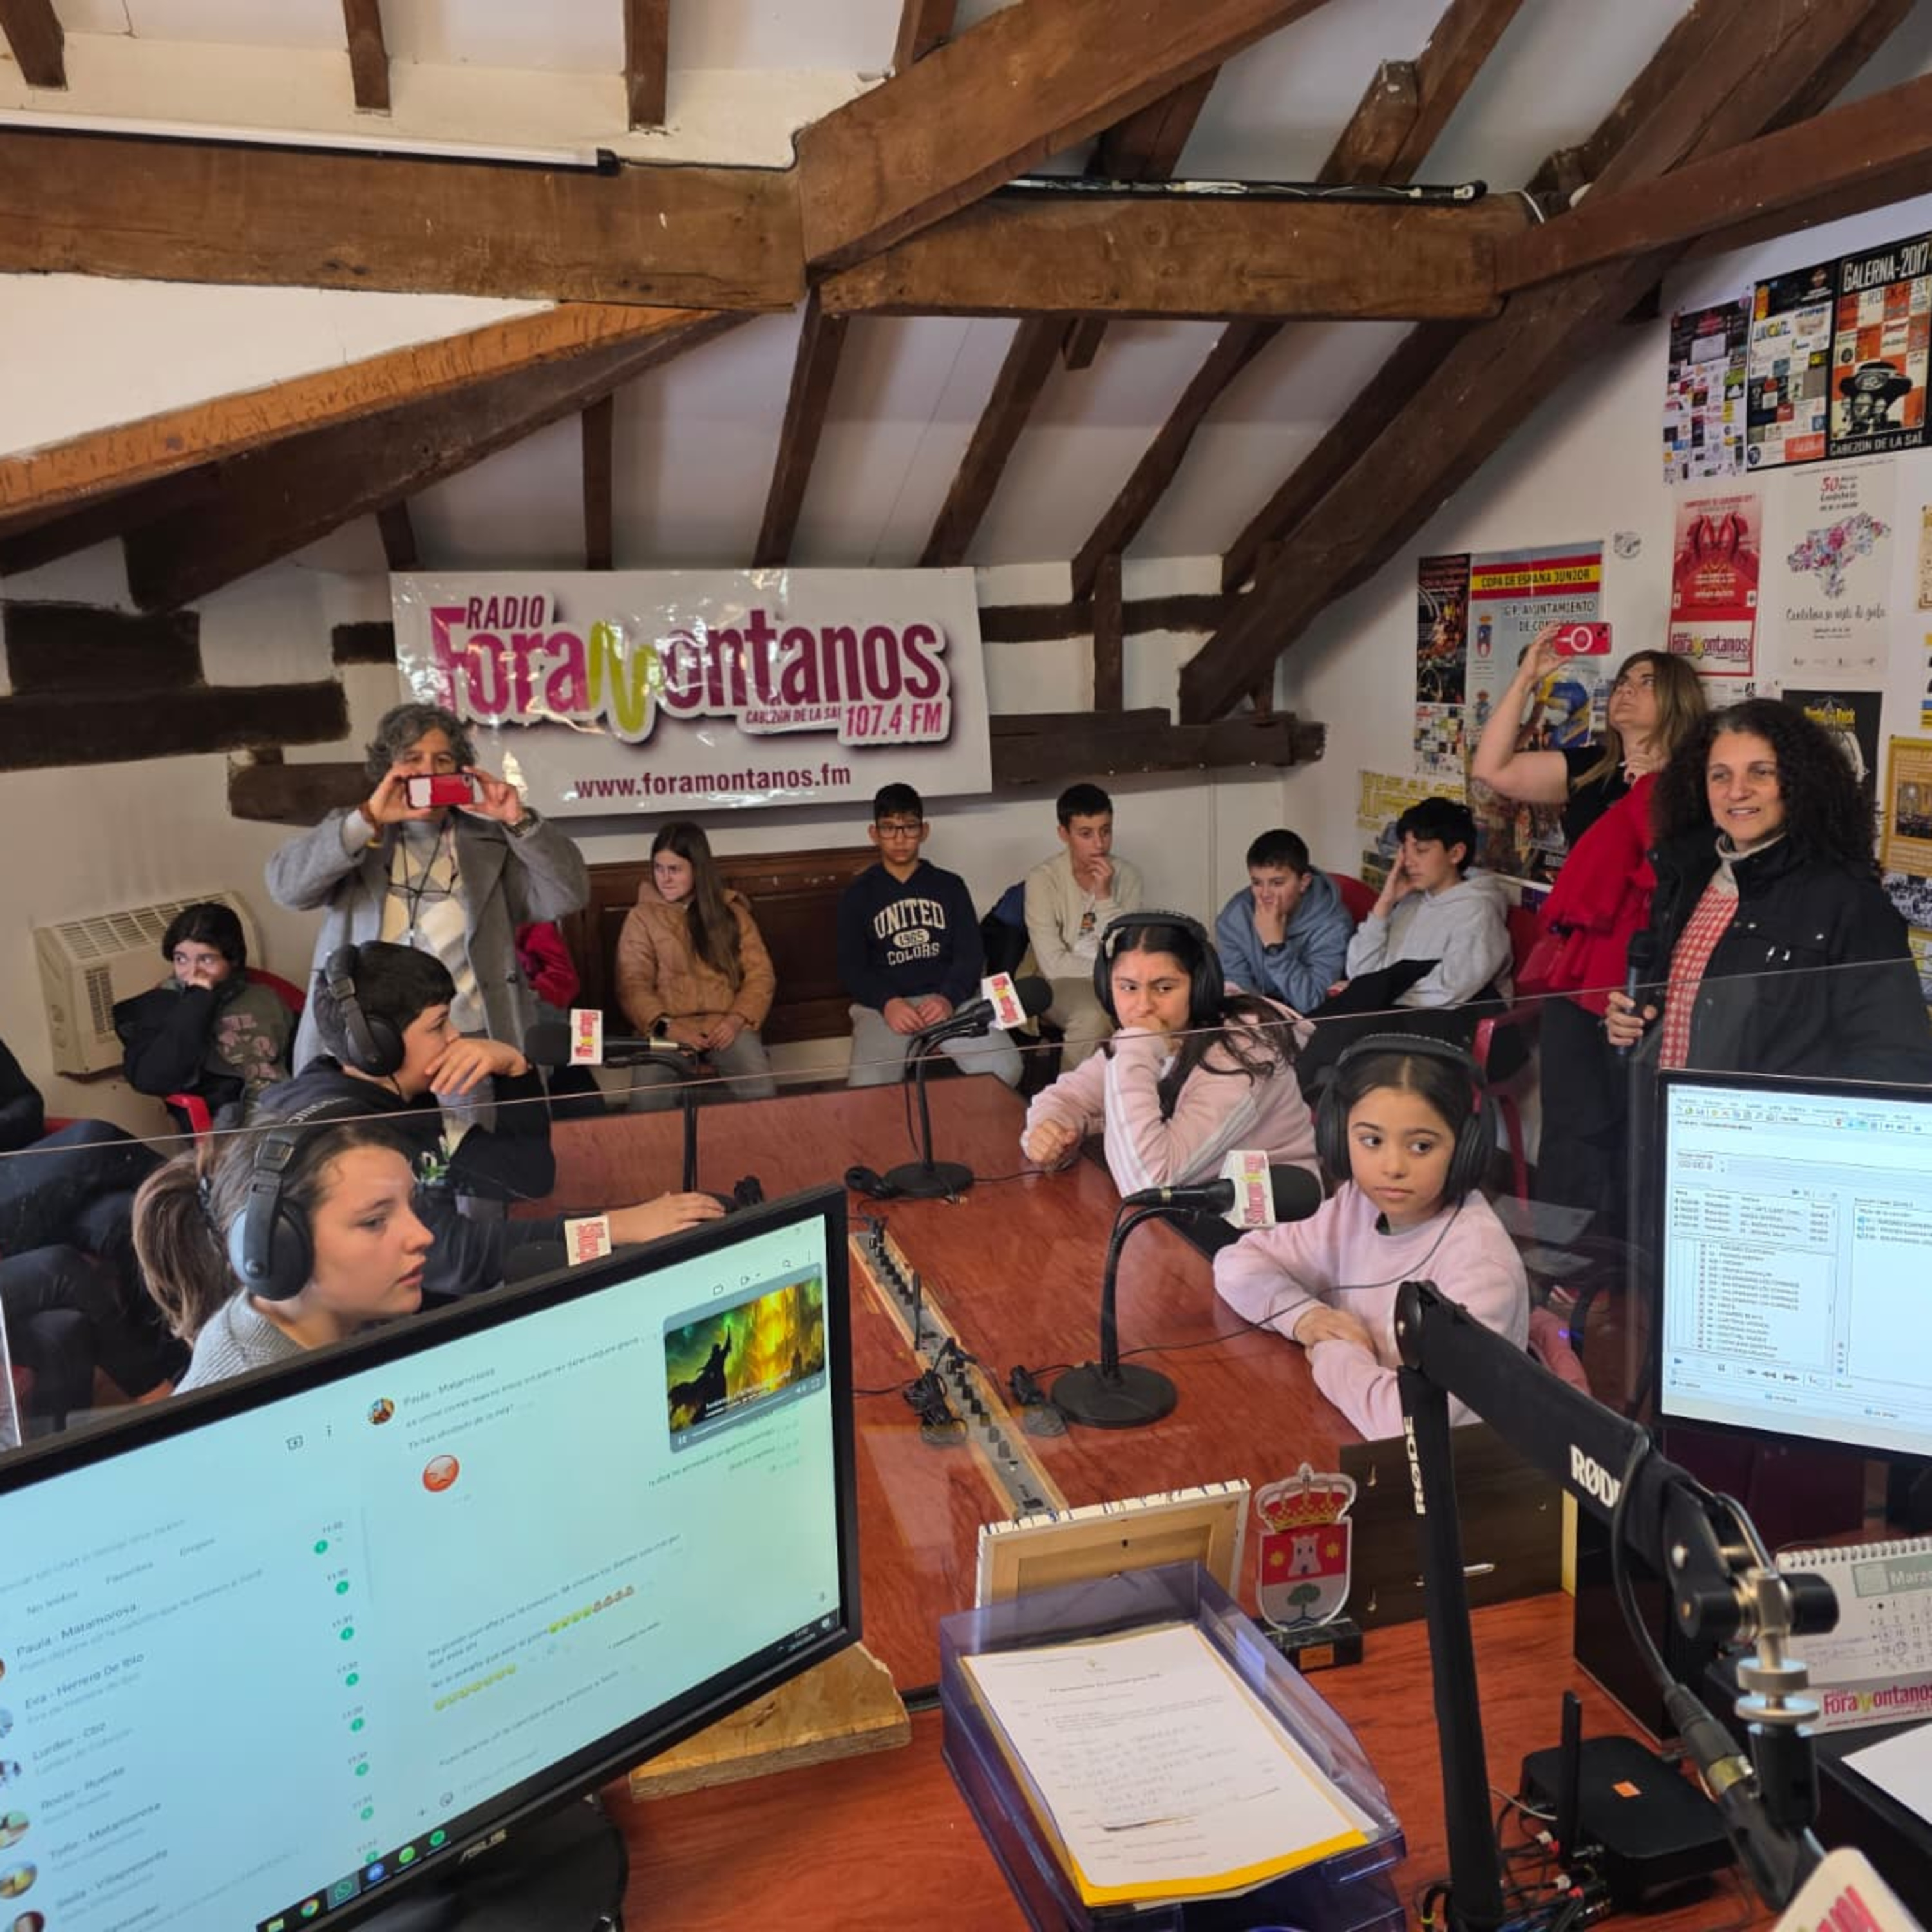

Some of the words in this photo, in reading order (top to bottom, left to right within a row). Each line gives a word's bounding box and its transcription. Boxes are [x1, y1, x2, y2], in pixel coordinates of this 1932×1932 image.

[1555, 567, 1590, 583] JUNIOR
[466, 595, 544, 630] RADIO
[1524, 601, 1595, 614] AYUNTAMIENTO
[793, 708, 807, 721] DE
[809, 707, 822, 721] LA
[845, 704, 902, 738] 107.4
[910, 702, 942, 735] FM
[575, 763, 851, 798] www.foramontanos.fm
[874, 898, 945, 940] UNITED
[887, 942, 941, 966] COLORS
